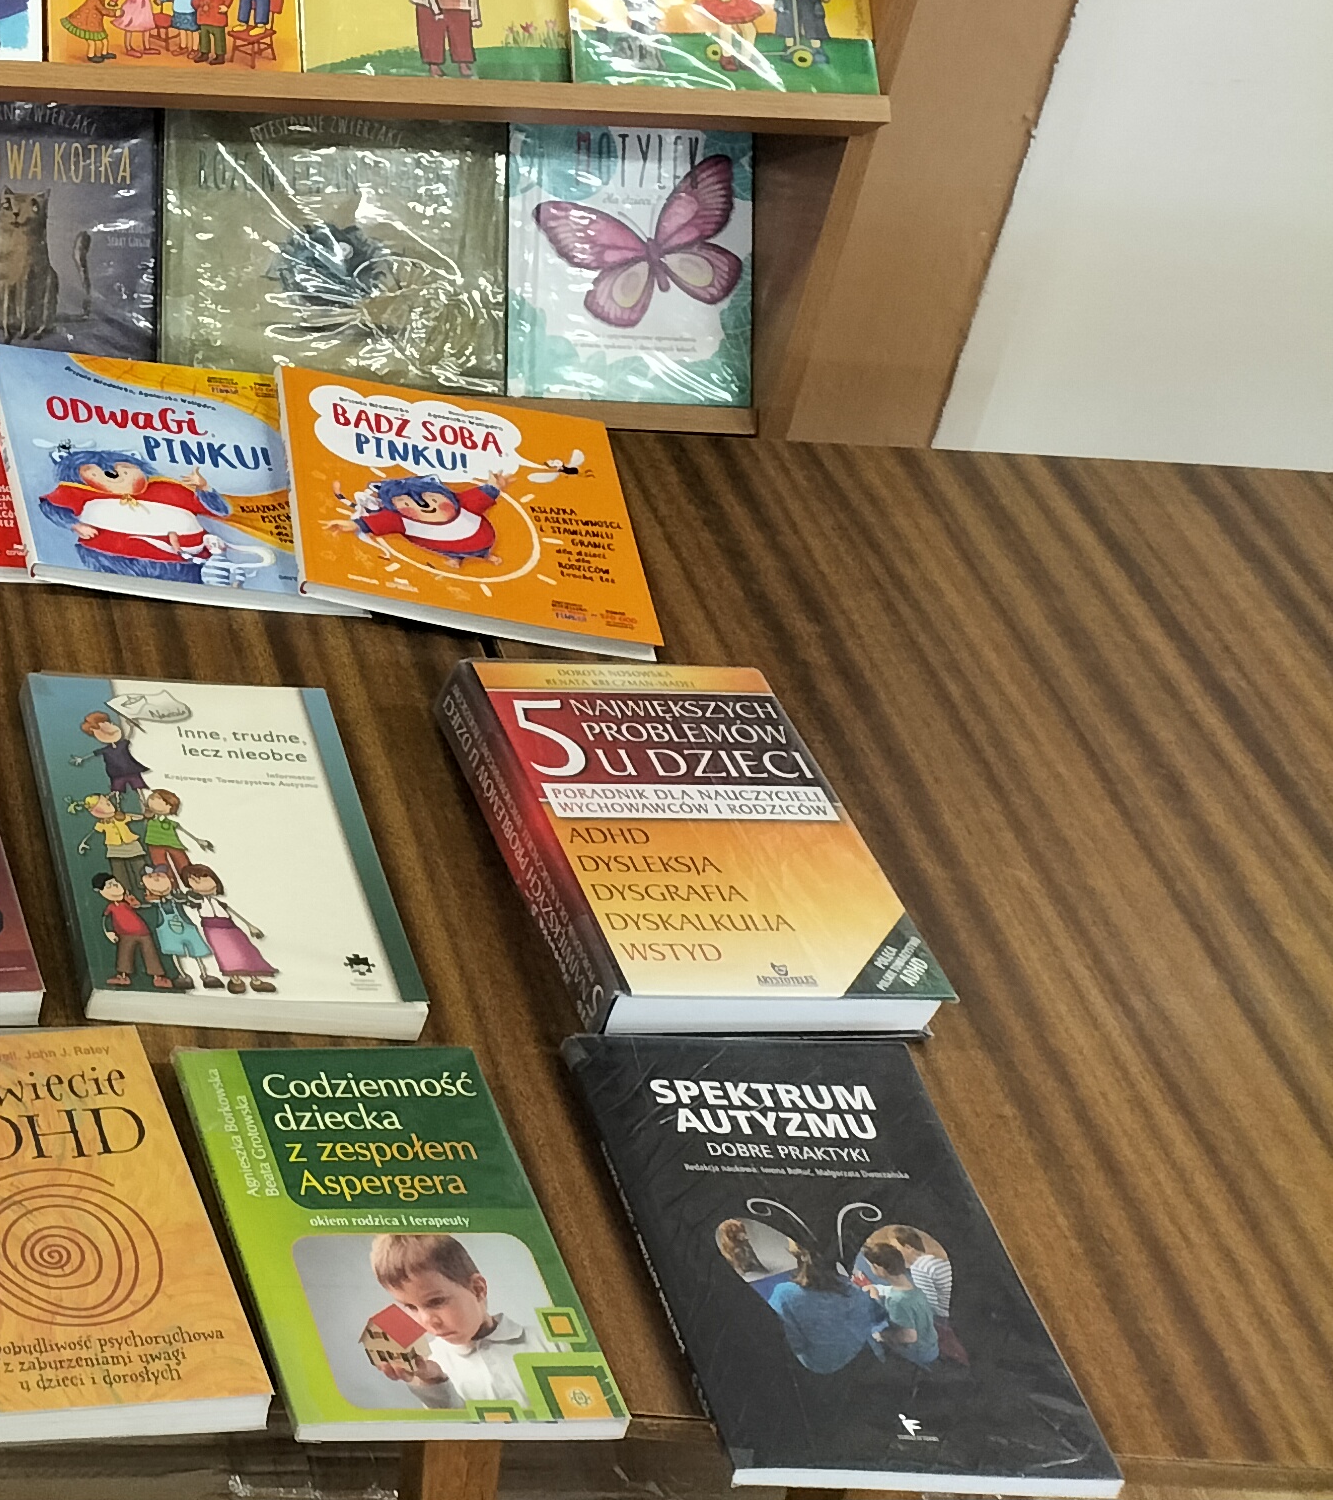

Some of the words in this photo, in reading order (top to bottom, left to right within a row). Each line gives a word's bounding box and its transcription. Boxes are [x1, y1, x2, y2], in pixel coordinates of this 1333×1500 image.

[141, 434, 273, 473] PINKU!
[354, 433, 468, 474] PINKU!
[176, 726, 226, 746] Inne,
[232, 728, 308, 747] trudne,
[513, 698, 588, 777] 5
[569, 699, 778, 723] NAJWIĘKSZYCH
[582, 721, 787, 745] PROBLEMÓW
[181, 742, 221, 761] lecz
[226, 748, 308, 764] nieobce
[646, 749, 814, 780] DZIECI
[551, 787, 650, 802] PORADNIK
[653, 787, 693, 802] DLA
[569, 827, 650, 845] ADHD
[576, 854, 723, 877] DYSLEKSJA
[589, 883, 749, 903] DYSGRAFIA
[604, 912, 796, 933] DYSKALKULIA
[619, 943, 722, 962] WSTYD
[261, 1069, 479, 1100] Codzienność
[650, 1079, 877, 1112] SPEKTRUM
[274, 1102, 403, 1131] dziecka
[676, 1108, 878, 1140] AUTYZMU
[315, 1135, 479, 1169] zespołem
[706, 1141, 774, 1160] DOBRE
[777, 1145, 872, 1163] PRAKTYKI
[299, 1169, 467, 1202] Aspergera
[351, 1214, 400, 1227] rodzica
[409, 1214, 471, 1231] terapeuty
